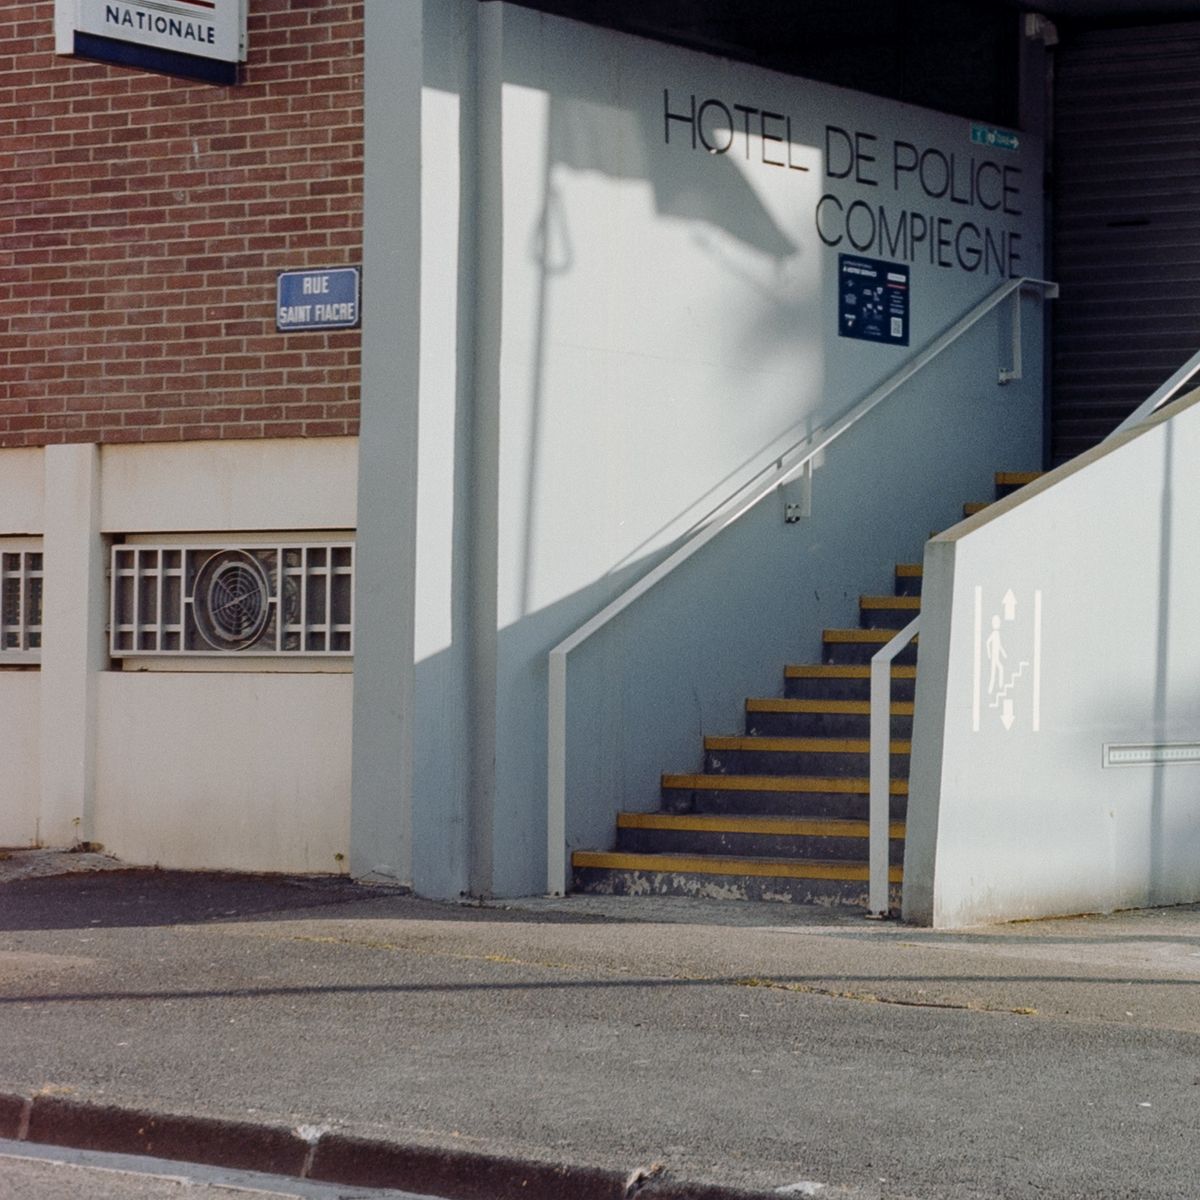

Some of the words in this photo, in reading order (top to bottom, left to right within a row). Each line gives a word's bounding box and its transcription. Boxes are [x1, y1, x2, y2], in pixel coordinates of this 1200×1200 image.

[106, 5, 215, 44] NATIONALE
[664, 89, 809, 172] HOTEL
[825, 125, 878, 186] DE
[894, 140, 1023, 216] POLICE
[816, 193, 1022, 279] COMPIEGNE
[302, 276, 329, 295] RUE
[280, 305, 312, 323] SAINT
[315, 302, 354, 322] FIACRE
